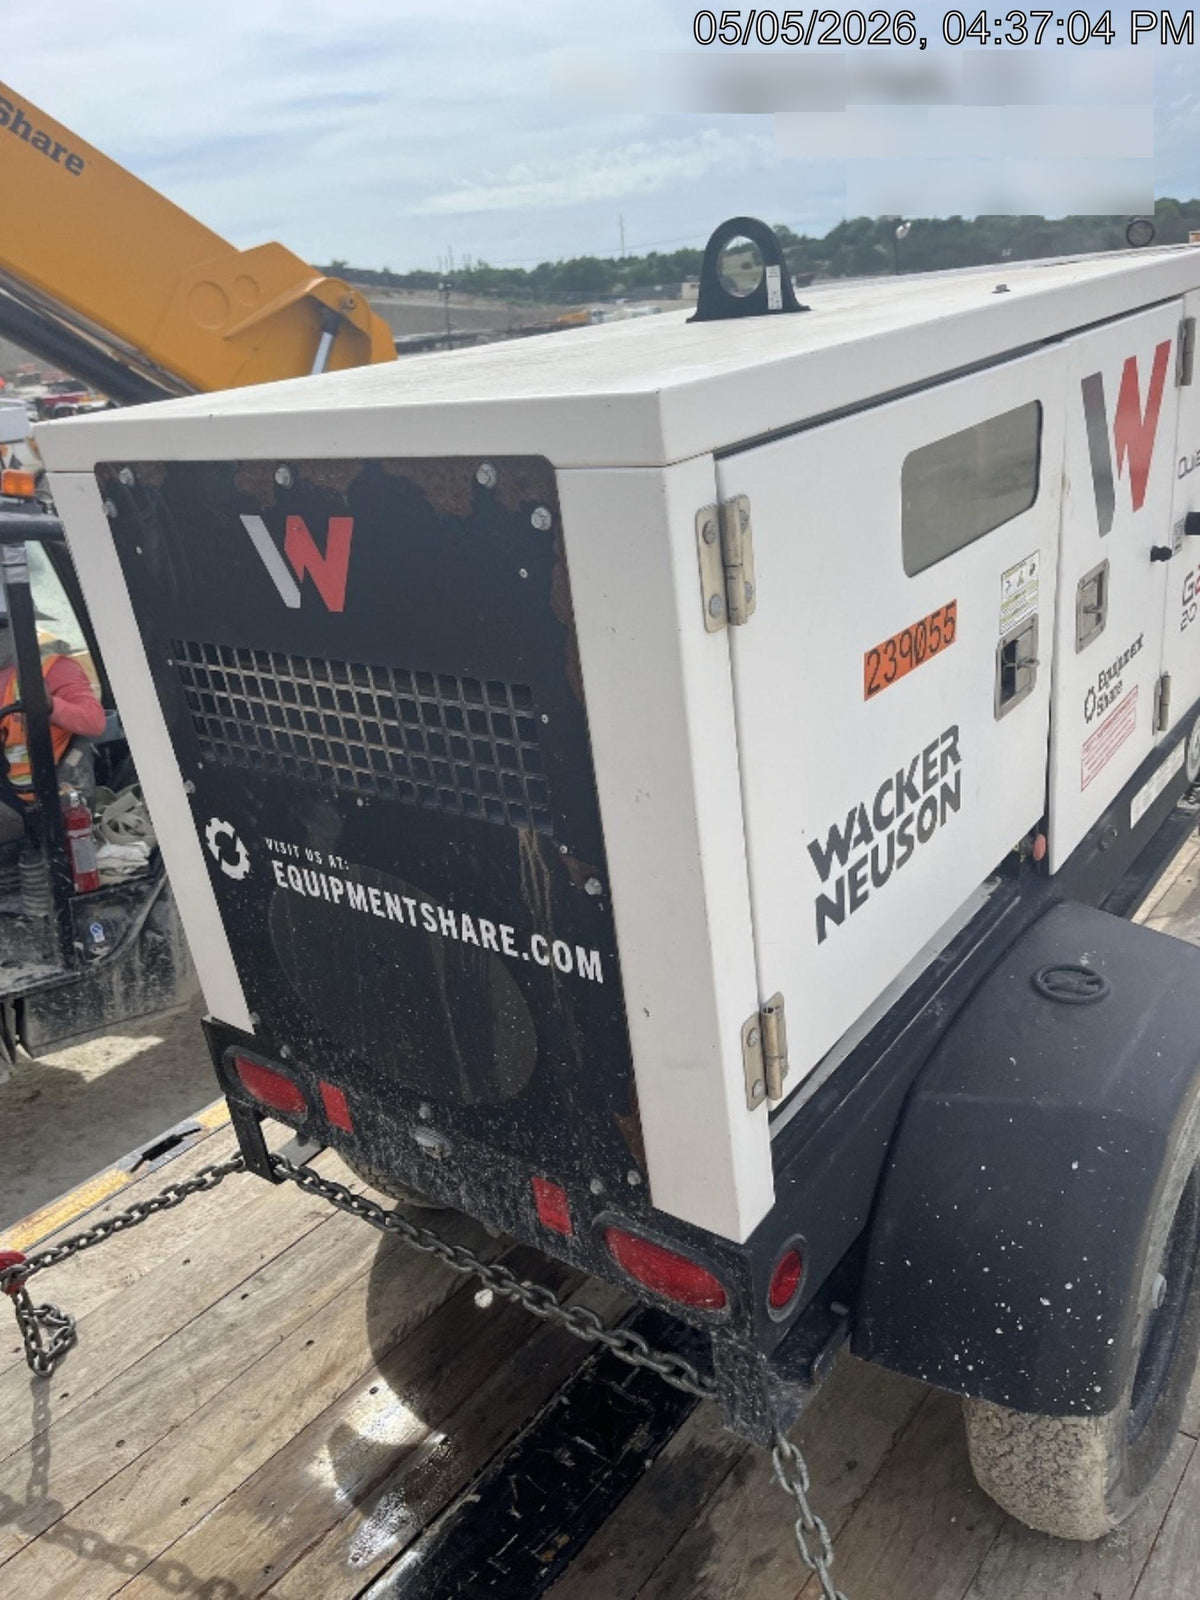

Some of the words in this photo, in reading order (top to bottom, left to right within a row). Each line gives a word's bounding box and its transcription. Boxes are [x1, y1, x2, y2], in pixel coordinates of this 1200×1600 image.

[866, 601, 957, 695] 239055
[264, 837, 299, 859] VISIT
[305, 848, 322, 865] US
[328, 854, 350, 870] AT:
[807, 725, 962, 883] WACKER
[815, 768, 961, 945] NEUSON
[271, 859, 604, 983] EQUIPMENTSHARE.COM
